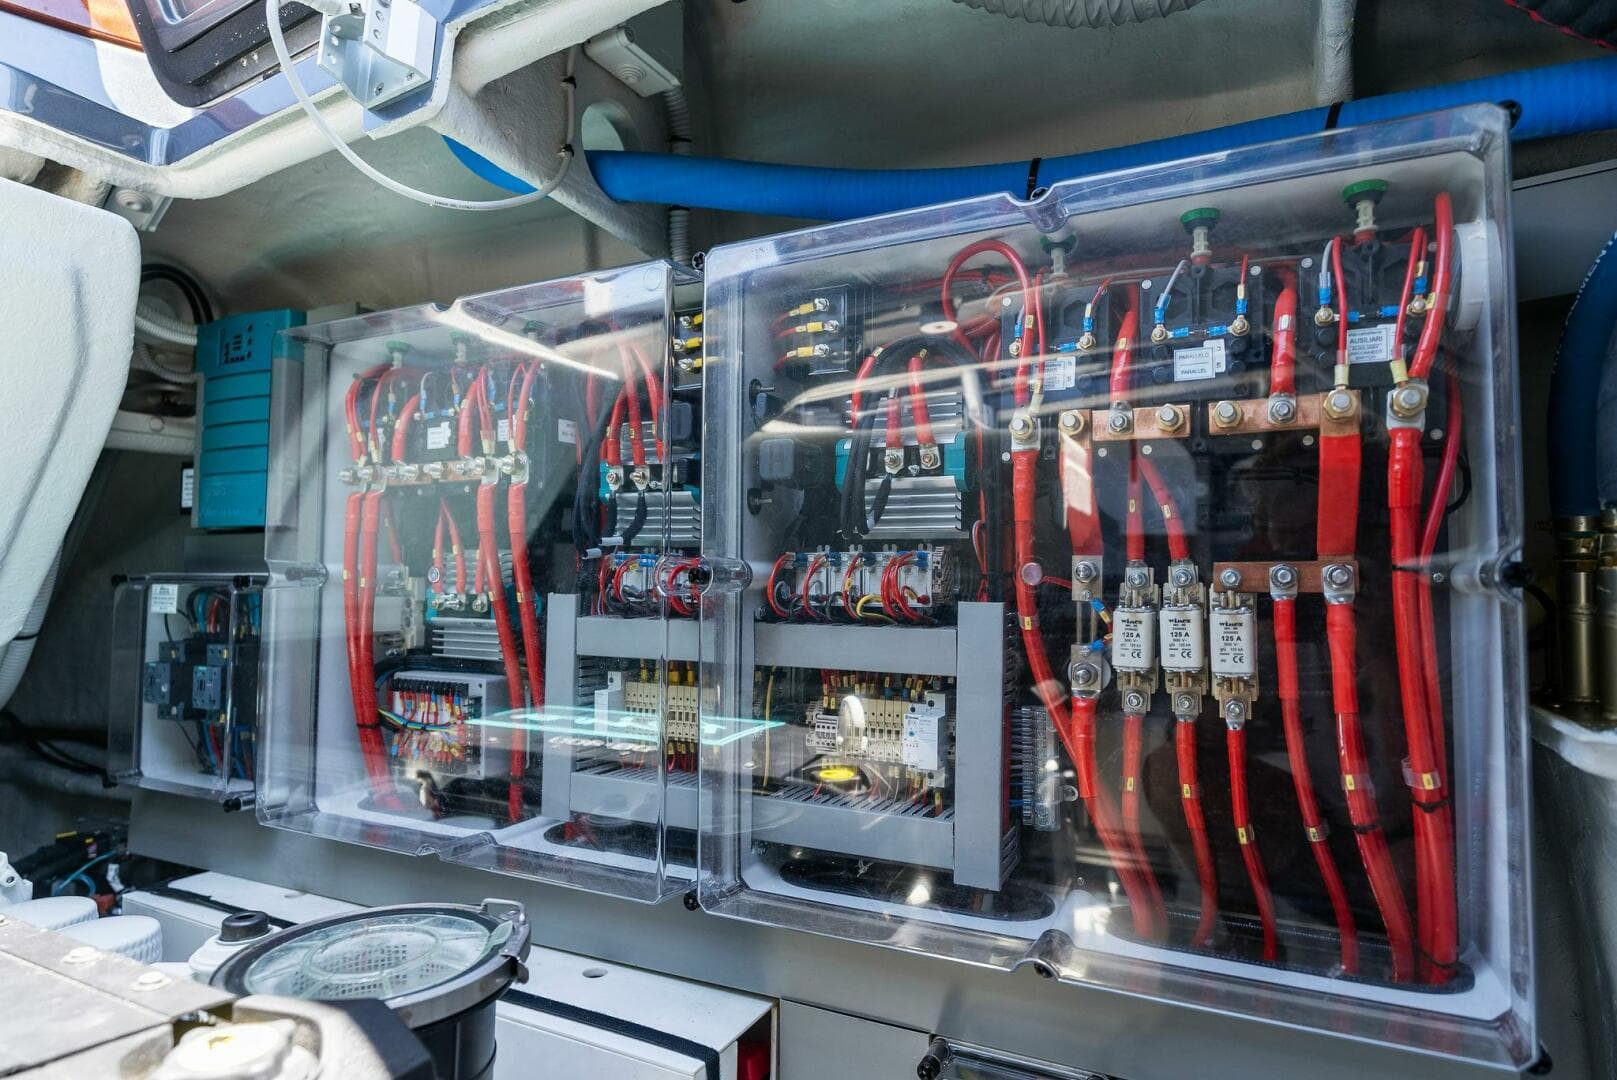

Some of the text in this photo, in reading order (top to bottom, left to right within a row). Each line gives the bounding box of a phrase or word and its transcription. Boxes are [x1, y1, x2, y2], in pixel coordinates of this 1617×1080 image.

[1131, 650, 1142, 659] CE
[1181, 650, 1192, 659] CE
[1232, 655, 1245, 664] CE
